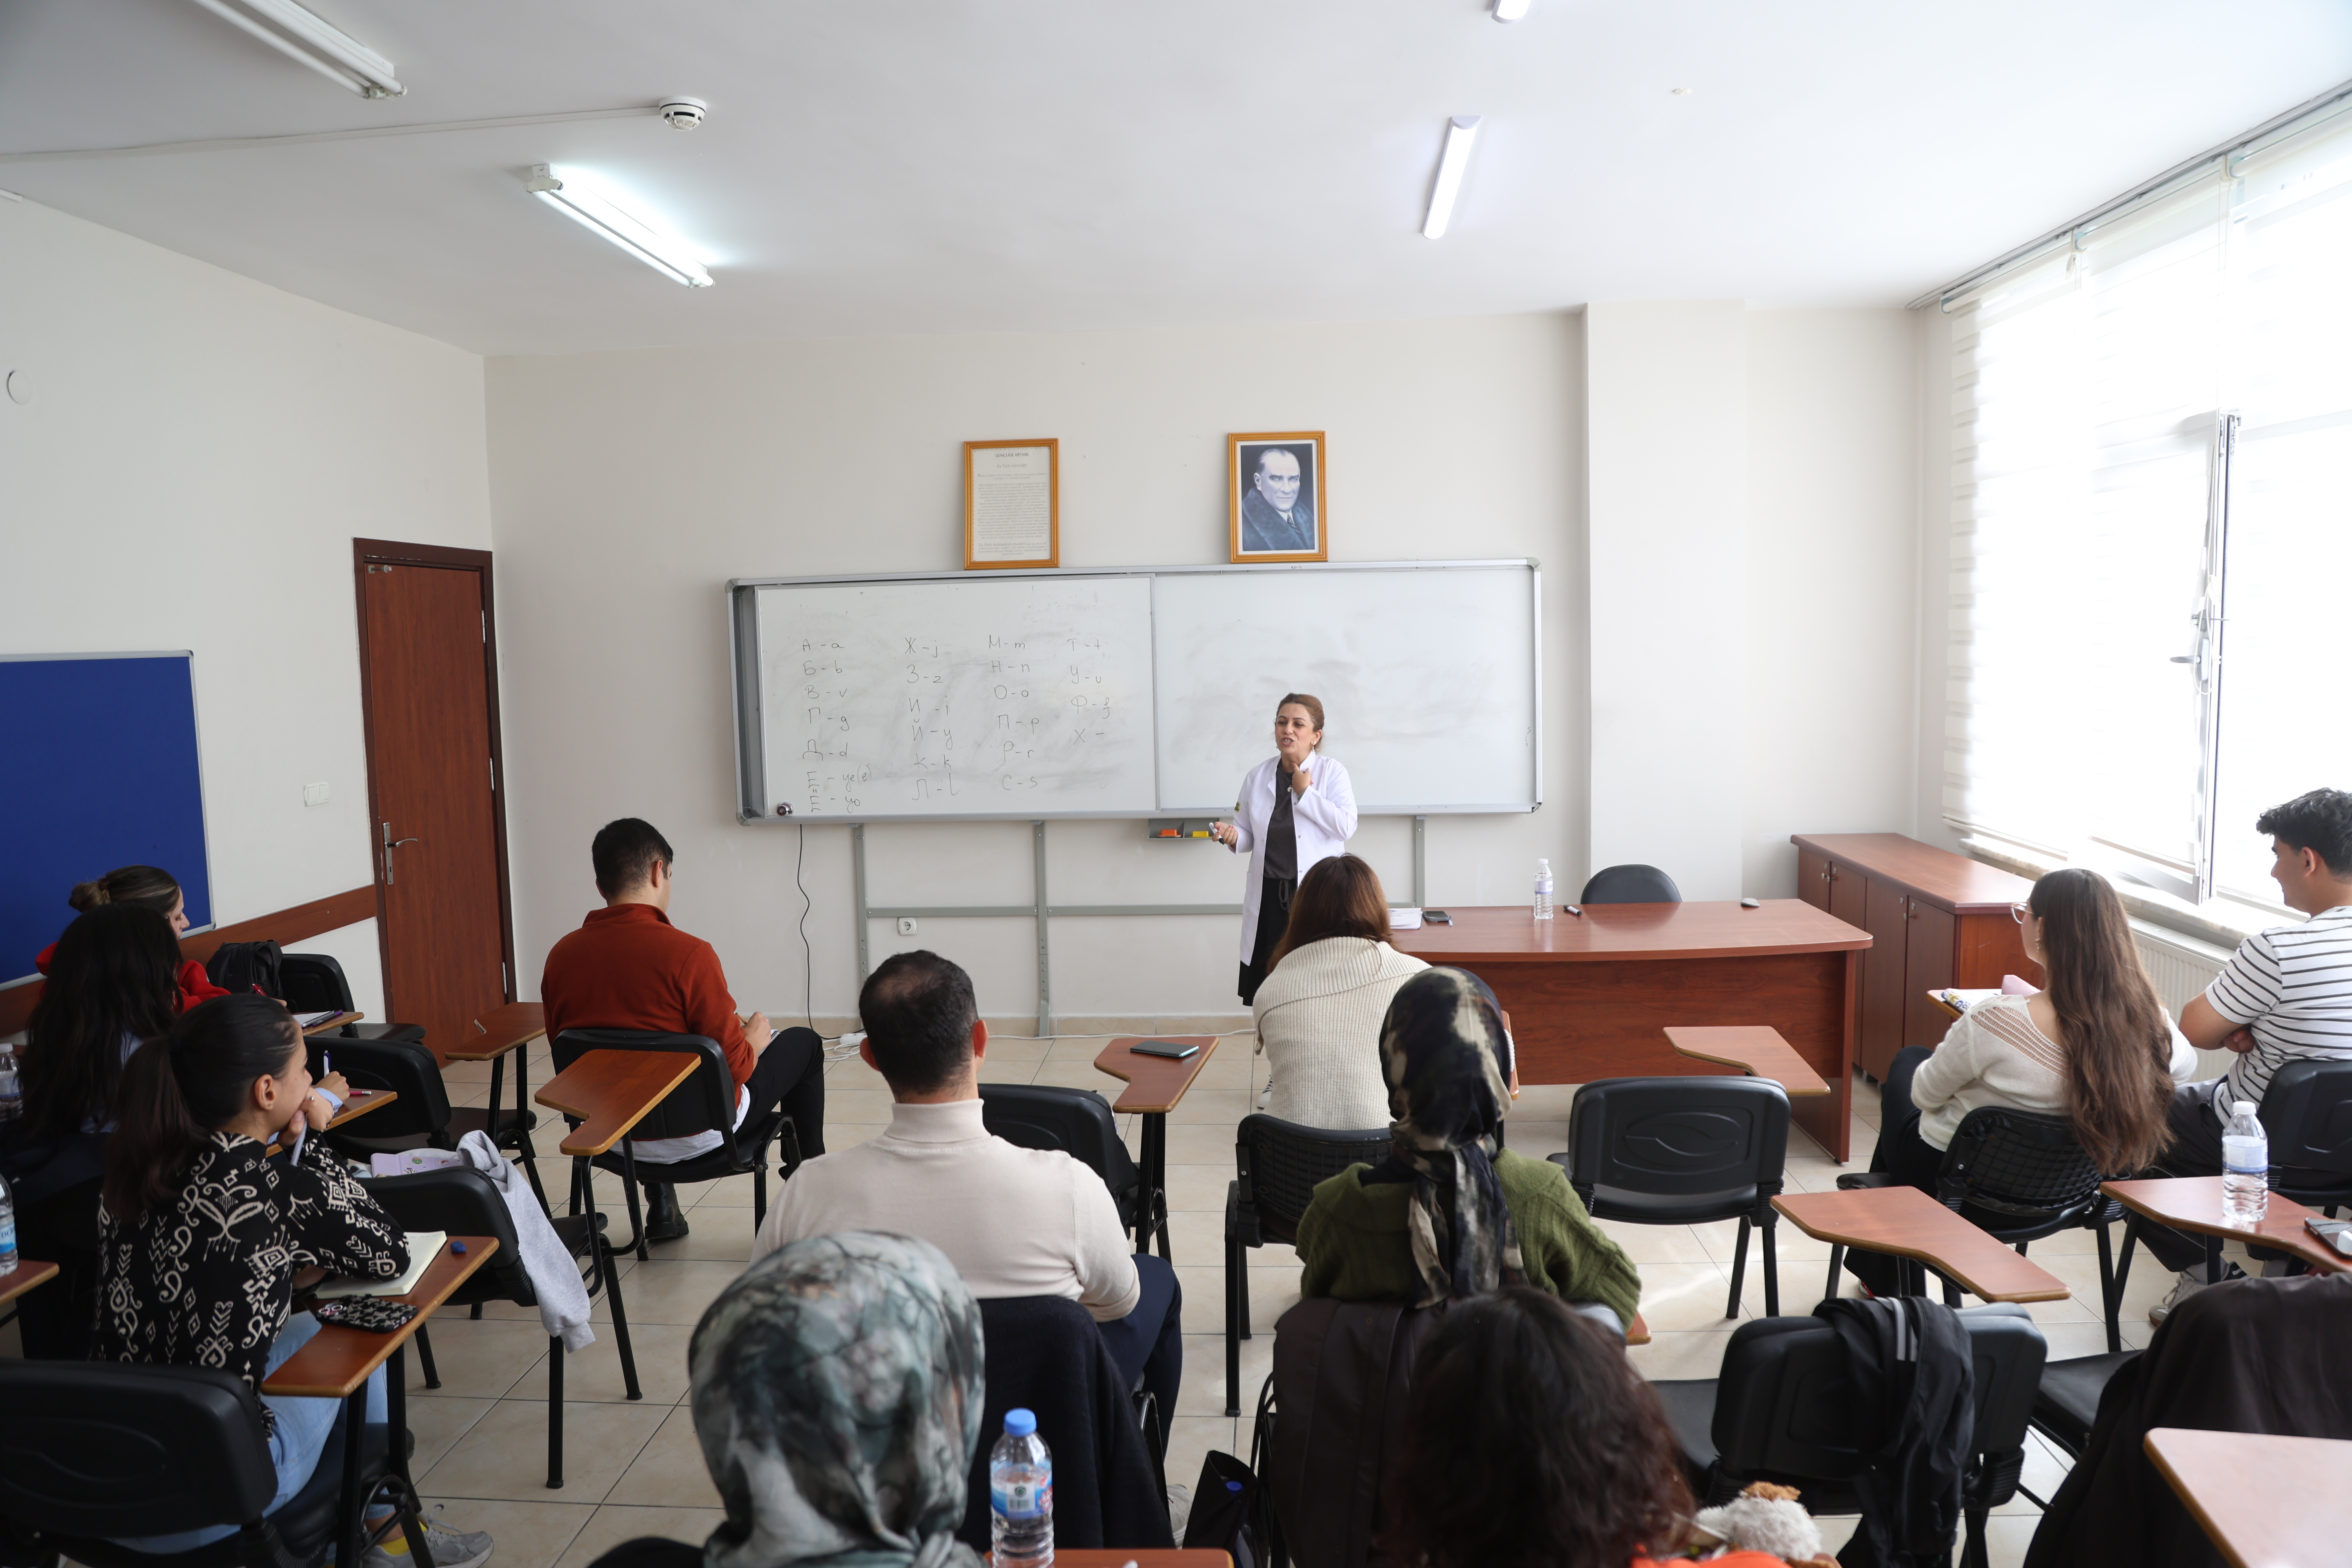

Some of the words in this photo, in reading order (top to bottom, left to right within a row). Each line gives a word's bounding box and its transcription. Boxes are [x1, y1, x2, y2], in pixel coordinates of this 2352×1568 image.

[904, 637, 916, 654] Ж
[932, 640, 938, 658] j
[1094, 639, 1101, 650] t
[802, 660, 816, 676] Б
[834, 659, 843, 673] b
[906, 664, 919, 684] З
[1021, 663, 1030, 673] n
[839, 688, 848, 697] v
[1021, 690, 1029, 698] o
[909, 697, 920, 713] И
[945, 695, 949, 716] i
[1071, 695, 1088, 714] Ф
[1102, 697, 1111, 719] f
[808, 707, 821, 724] Г
[840, 716, 850, 731] g
[998, 714, 1010, 729] П
[1031, 717, 1040, 735] p
[912, 718, 923, 741] Й
[943, 729, 953, 750] y
[802, 739, 824, 761] Д
[839, 742, 848, 758] d
[1027, 750, 1034, 759] r
[943, 754, 951, 769] k
[842, 764, 872, 793] ye(e)
[912, 779, 929, 800] Л
[949, 772, 958, 796] l
[1029, 776, 1038, 788] s
[845, 796, 860, 814] yo
